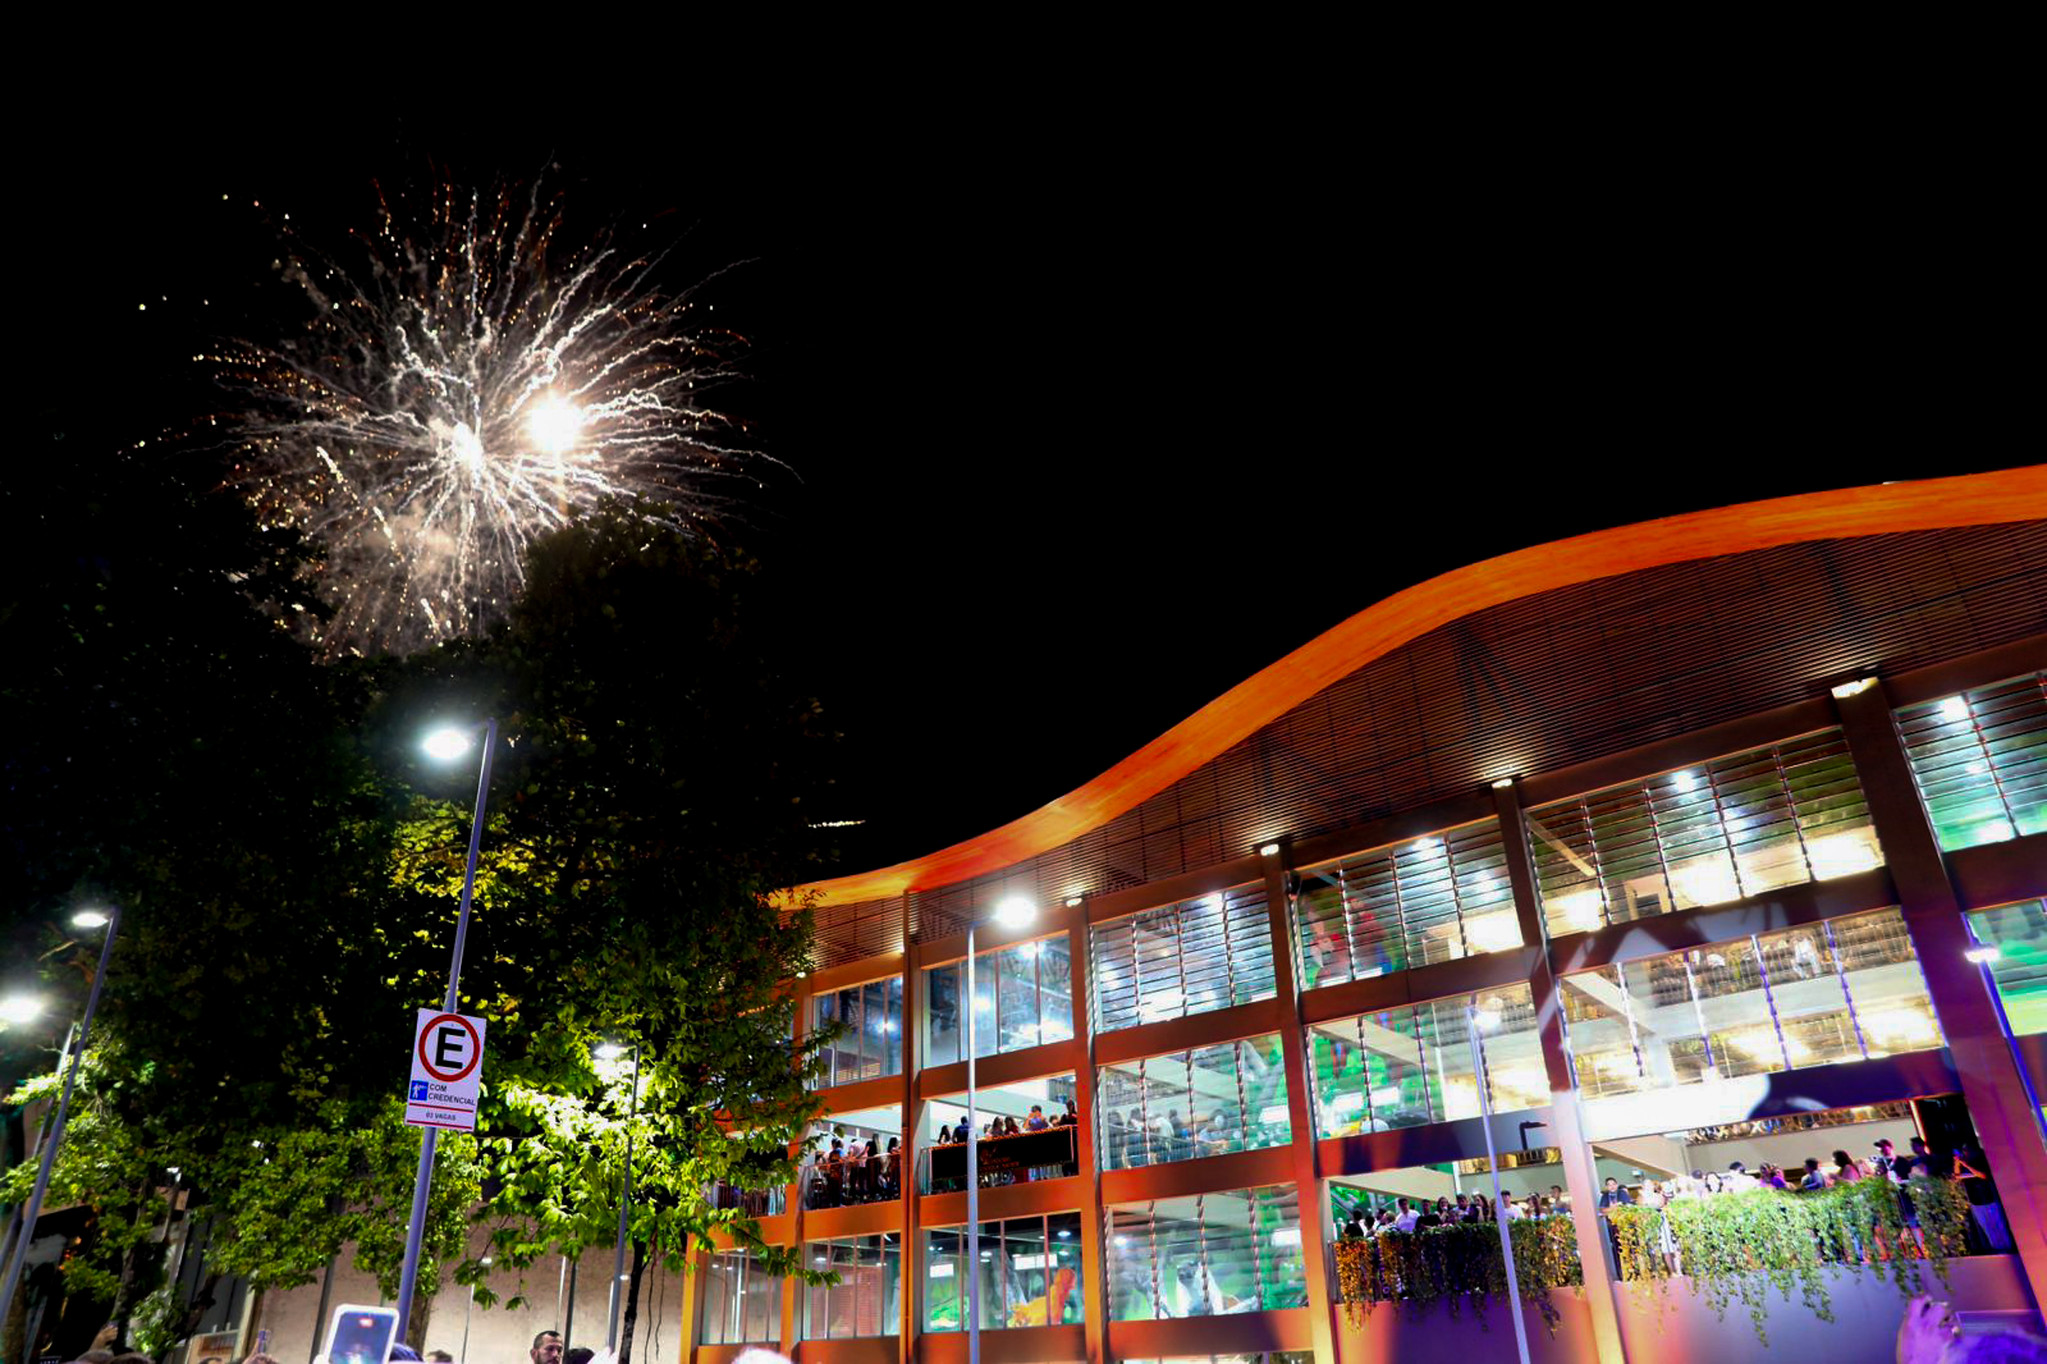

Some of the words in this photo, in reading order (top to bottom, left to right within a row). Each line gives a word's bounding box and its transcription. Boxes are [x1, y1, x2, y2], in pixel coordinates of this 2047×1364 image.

[435, 1027, 466, 1069] E
[429, 1083, 447, 1092] COM
[428, 1093, 475, 1105] CREDENCIAL
